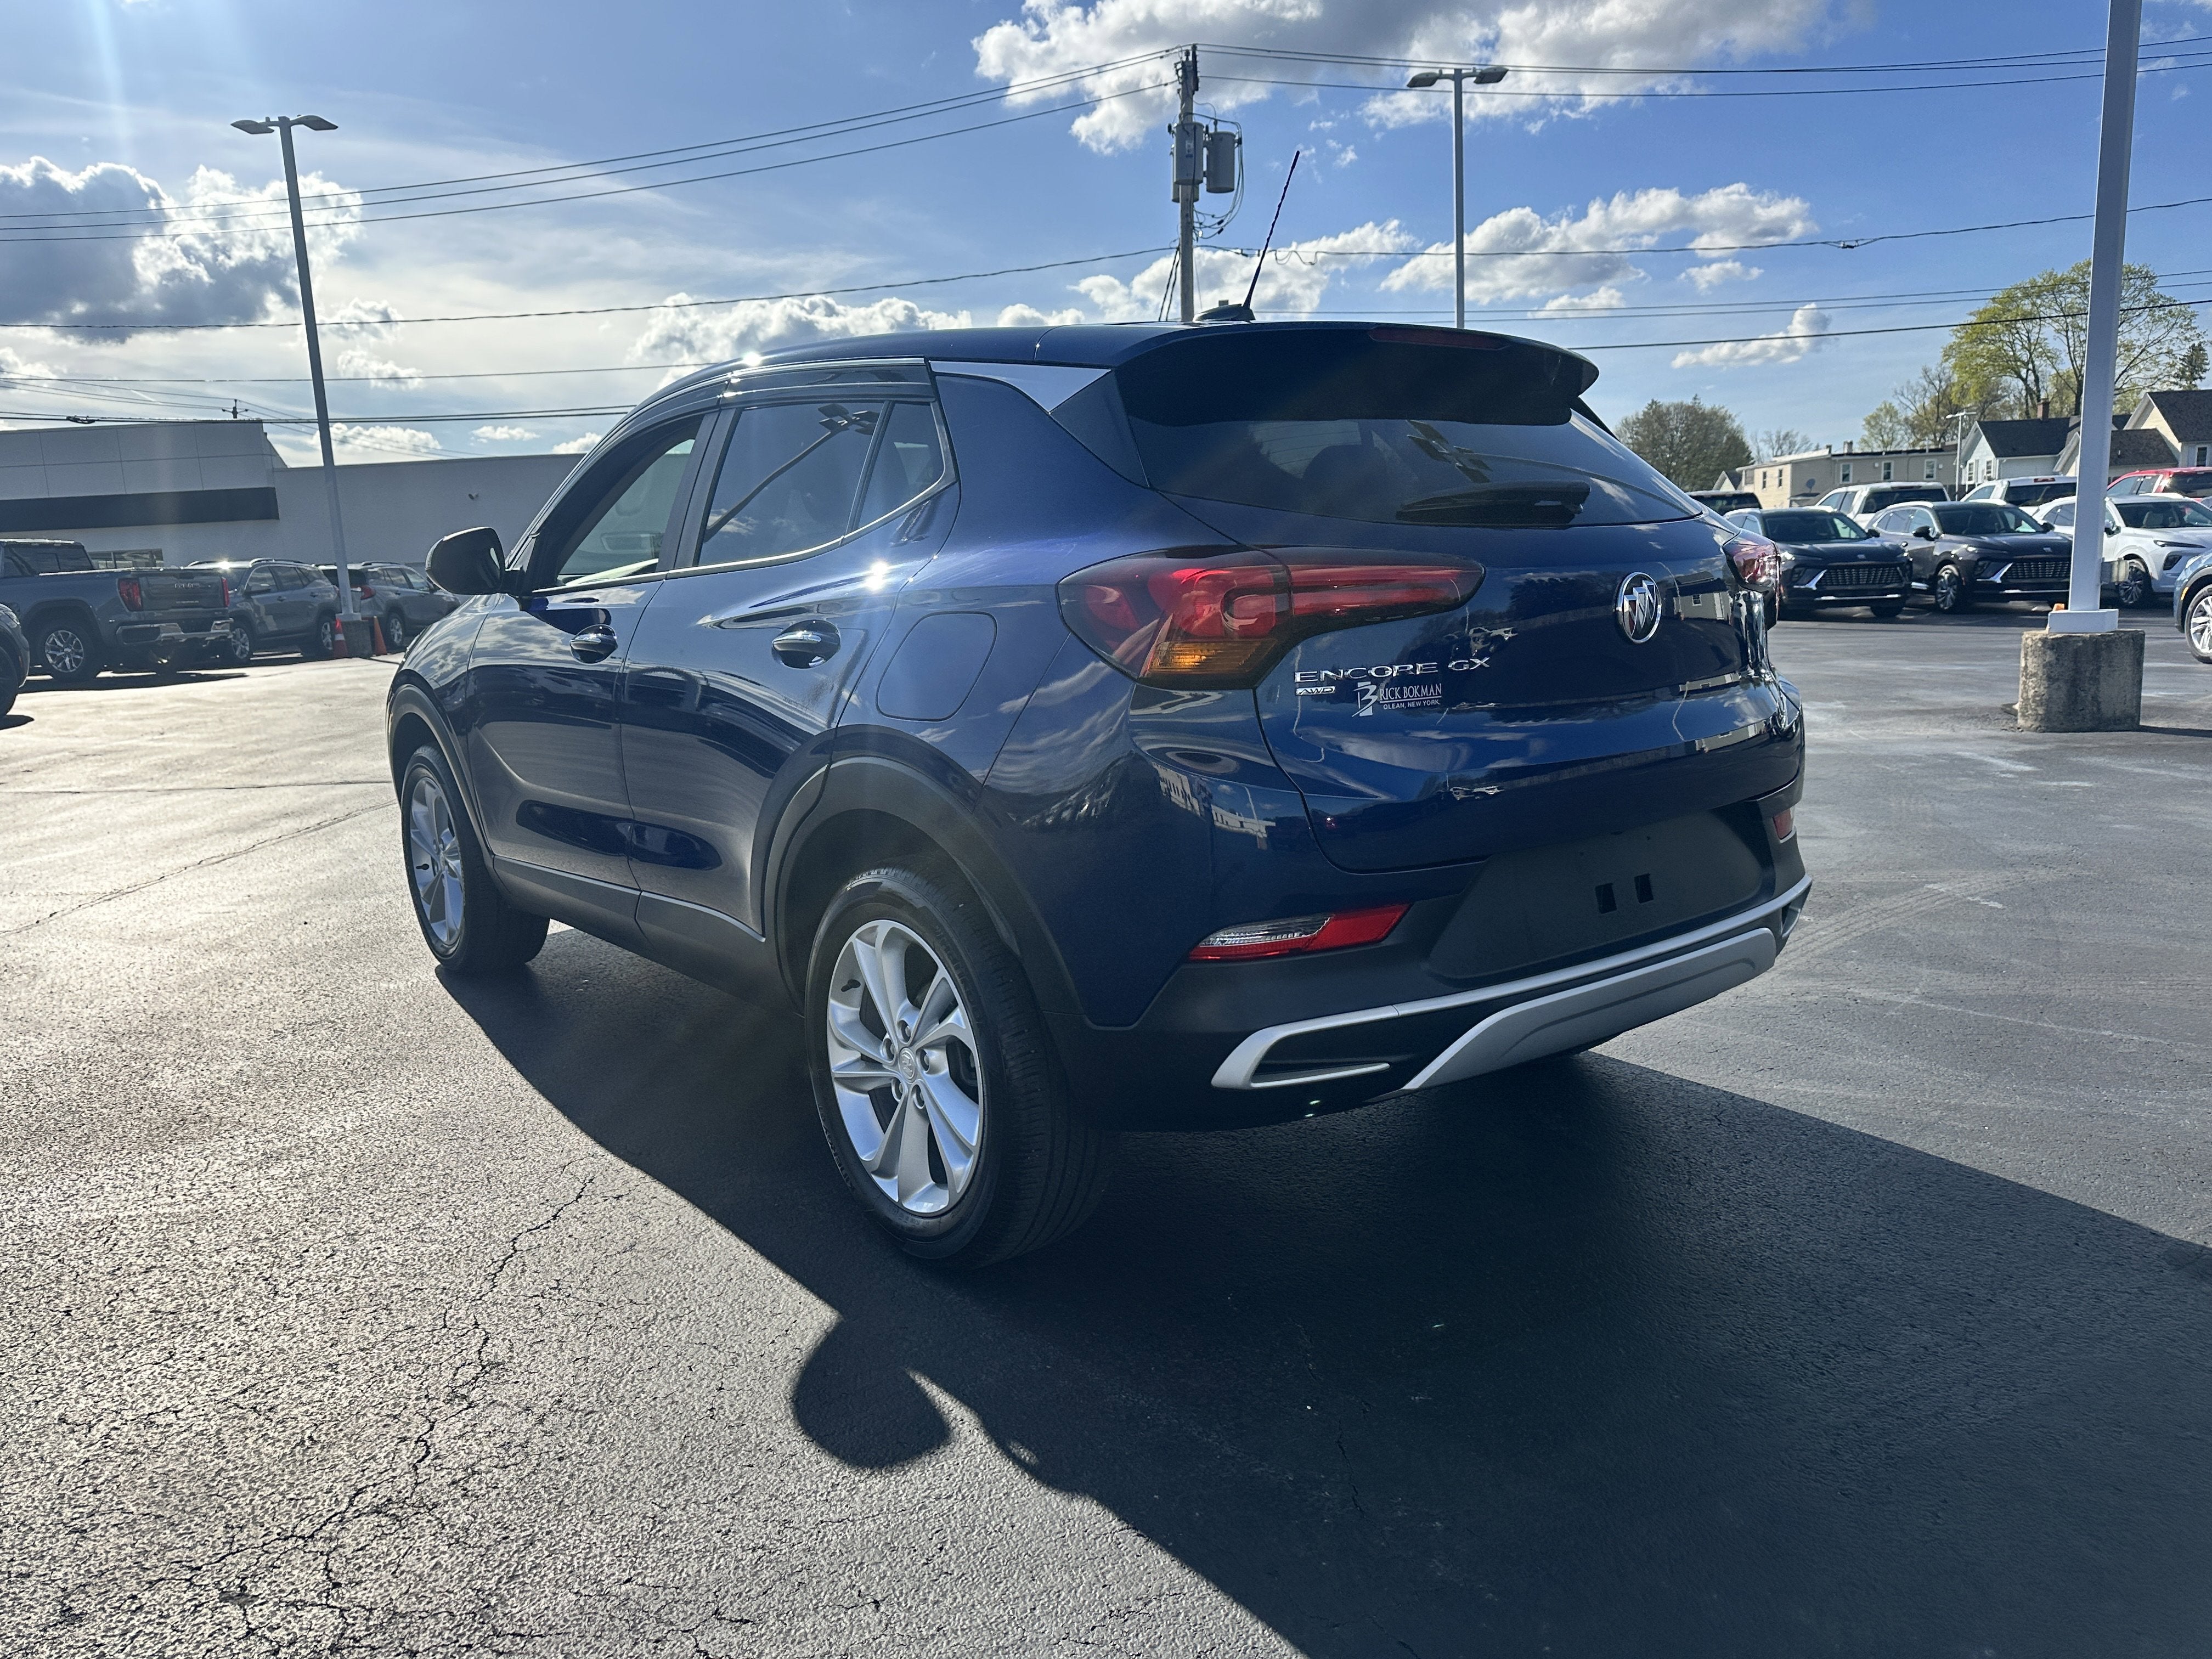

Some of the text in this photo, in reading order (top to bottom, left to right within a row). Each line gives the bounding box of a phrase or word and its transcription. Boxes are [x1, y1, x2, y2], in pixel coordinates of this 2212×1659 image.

[1294, 657, 1490, 683] ENCORE GX
[1296, 686, 1335, 695] AWD
[1380, 683, 1442, 700] RICK BOKMAN
